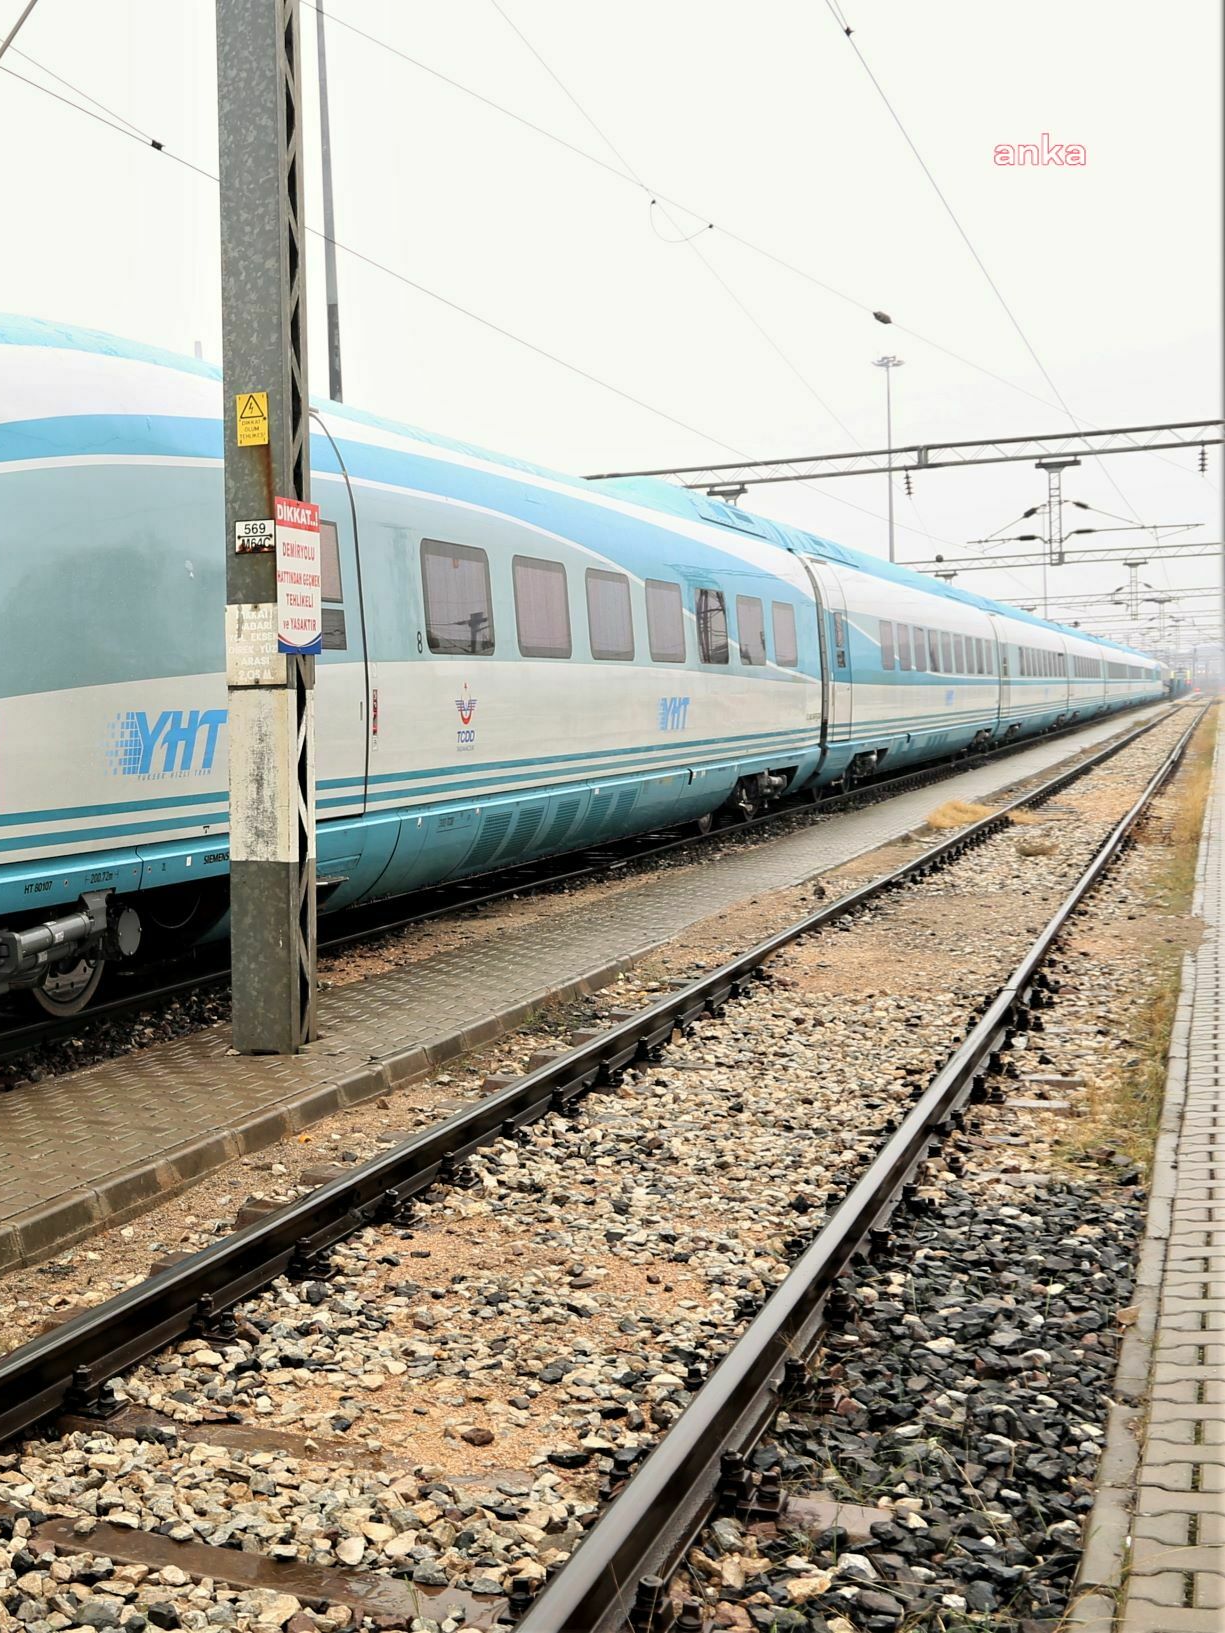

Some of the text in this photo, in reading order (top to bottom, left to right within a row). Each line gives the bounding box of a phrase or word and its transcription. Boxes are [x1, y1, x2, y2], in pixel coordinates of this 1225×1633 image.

[244, 522, 267, 535] 569
[282, 540, 316, 561] DEMİRYOLU
[286, 591, 314, 609] TEHLİKELİ
[290, 617, 317, 632] YASAKTIR
[416, 630, 423, 654] 8
[661, 696, 690, 730] YHT
[134, 709, 229, 775] YHT
[203, 851, 230, 865] SIEMENS
[24, 883, 34, 894] HT
